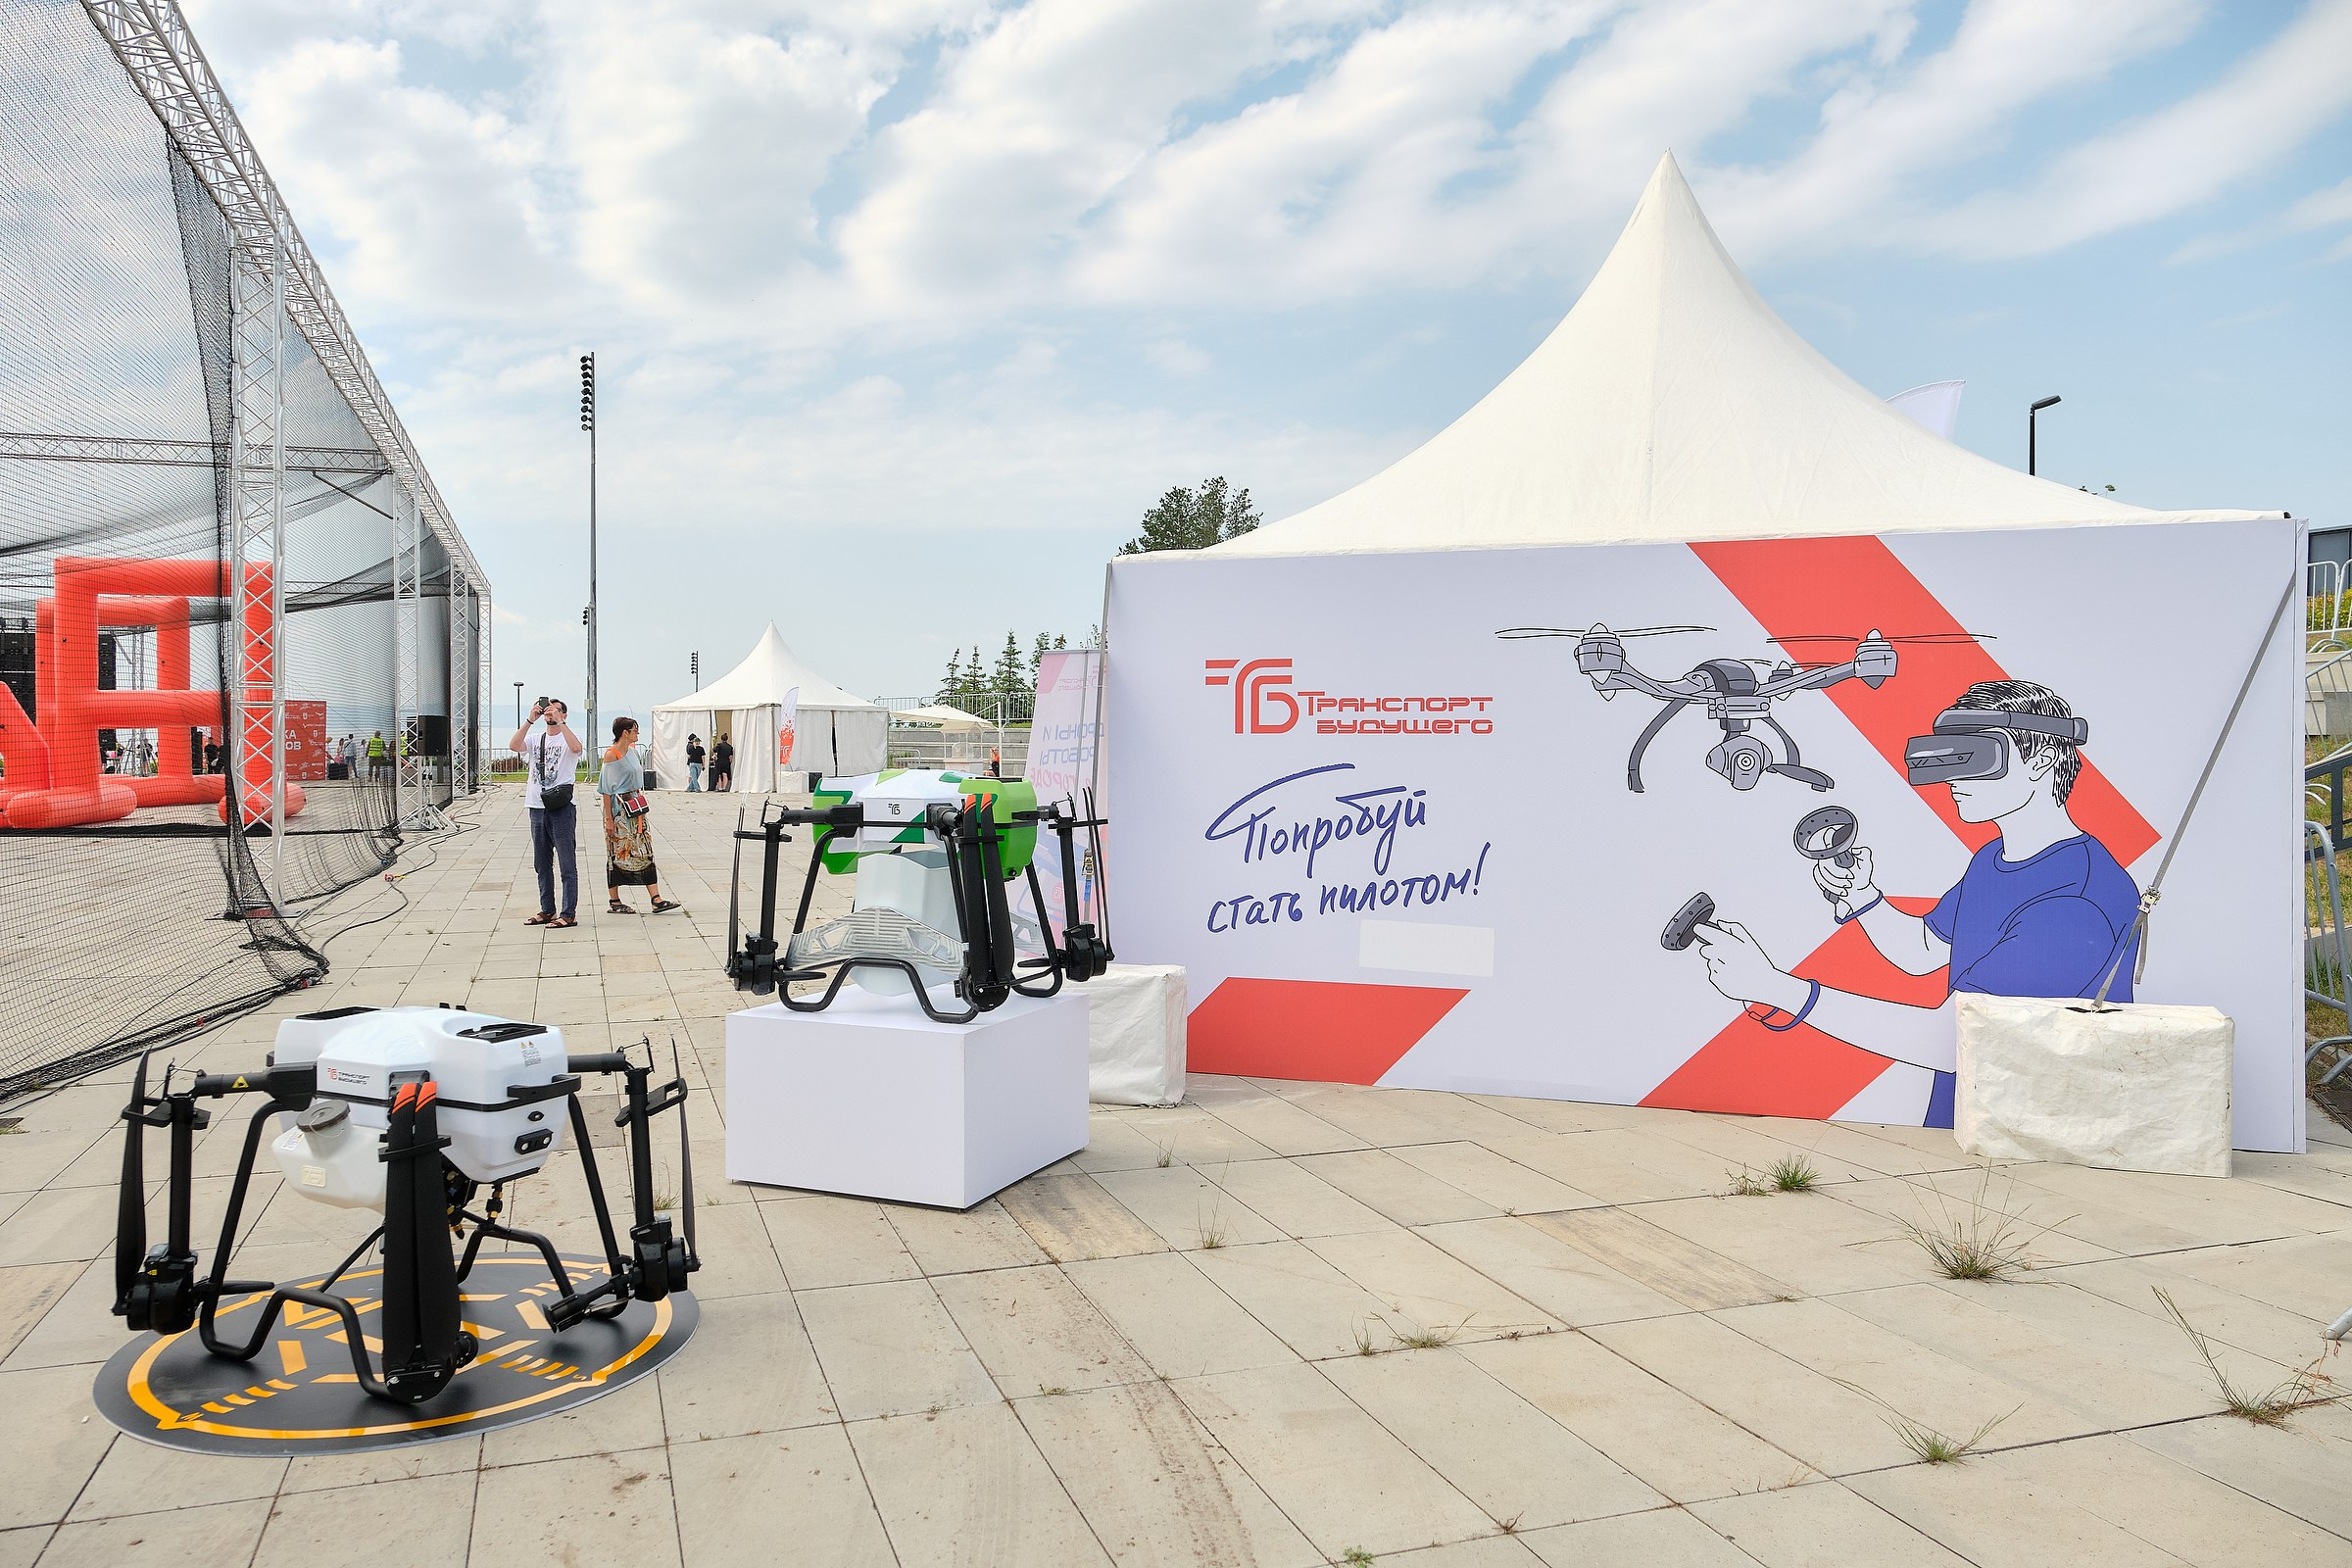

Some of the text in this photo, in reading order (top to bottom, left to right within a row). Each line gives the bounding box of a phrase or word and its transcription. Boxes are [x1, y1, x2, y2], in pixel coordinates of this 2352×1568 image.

[1298, 691, 1494, 716] ТРАНСПОРТ
[1316, 719, 1494, 734] БУДУЩЕГО
[1204, 762, 1427, 879] Попробуй
[1206, 841, 1492, 934] стать пилотом!
